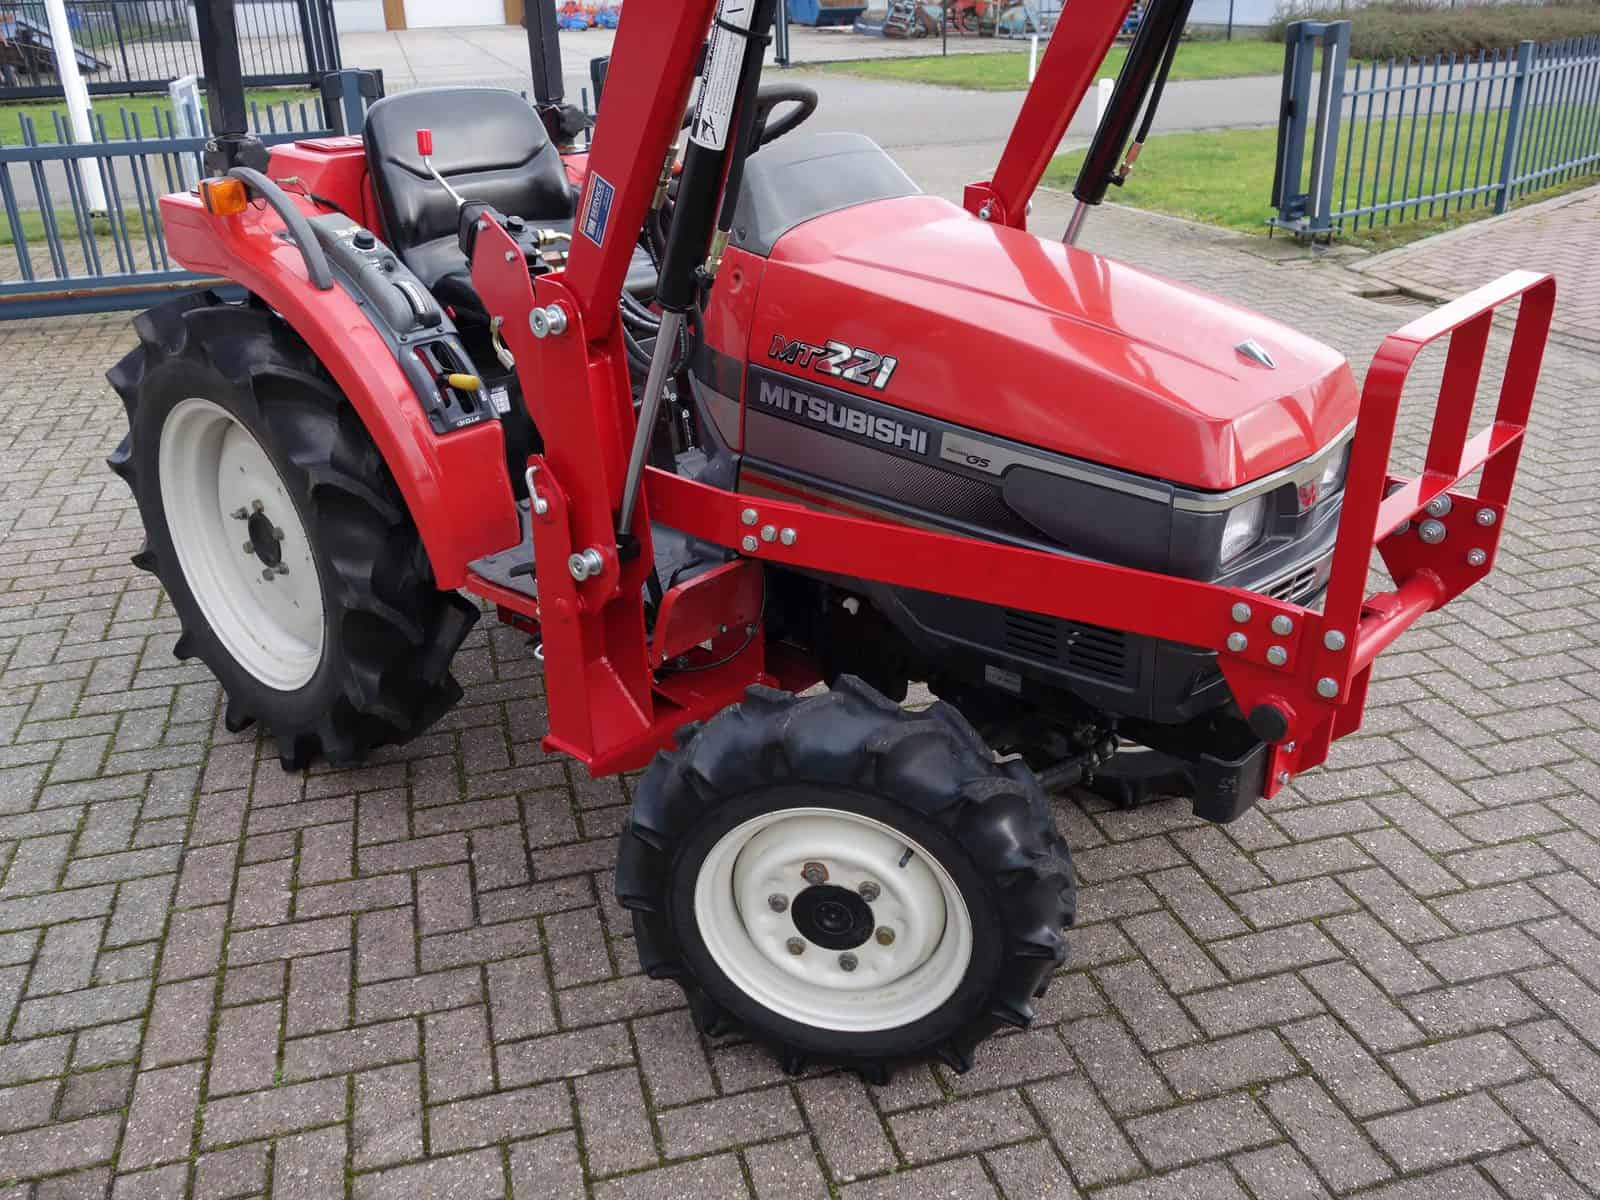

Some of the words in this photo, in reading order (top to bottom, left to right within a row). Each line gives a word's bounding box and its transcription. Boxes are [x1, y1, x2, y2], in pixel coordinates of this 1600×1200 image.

[768, 334, 898, 390] MT221
[759, 381, 929, 455] MITSUBISHI
[966, 455, 991, 468] GS
